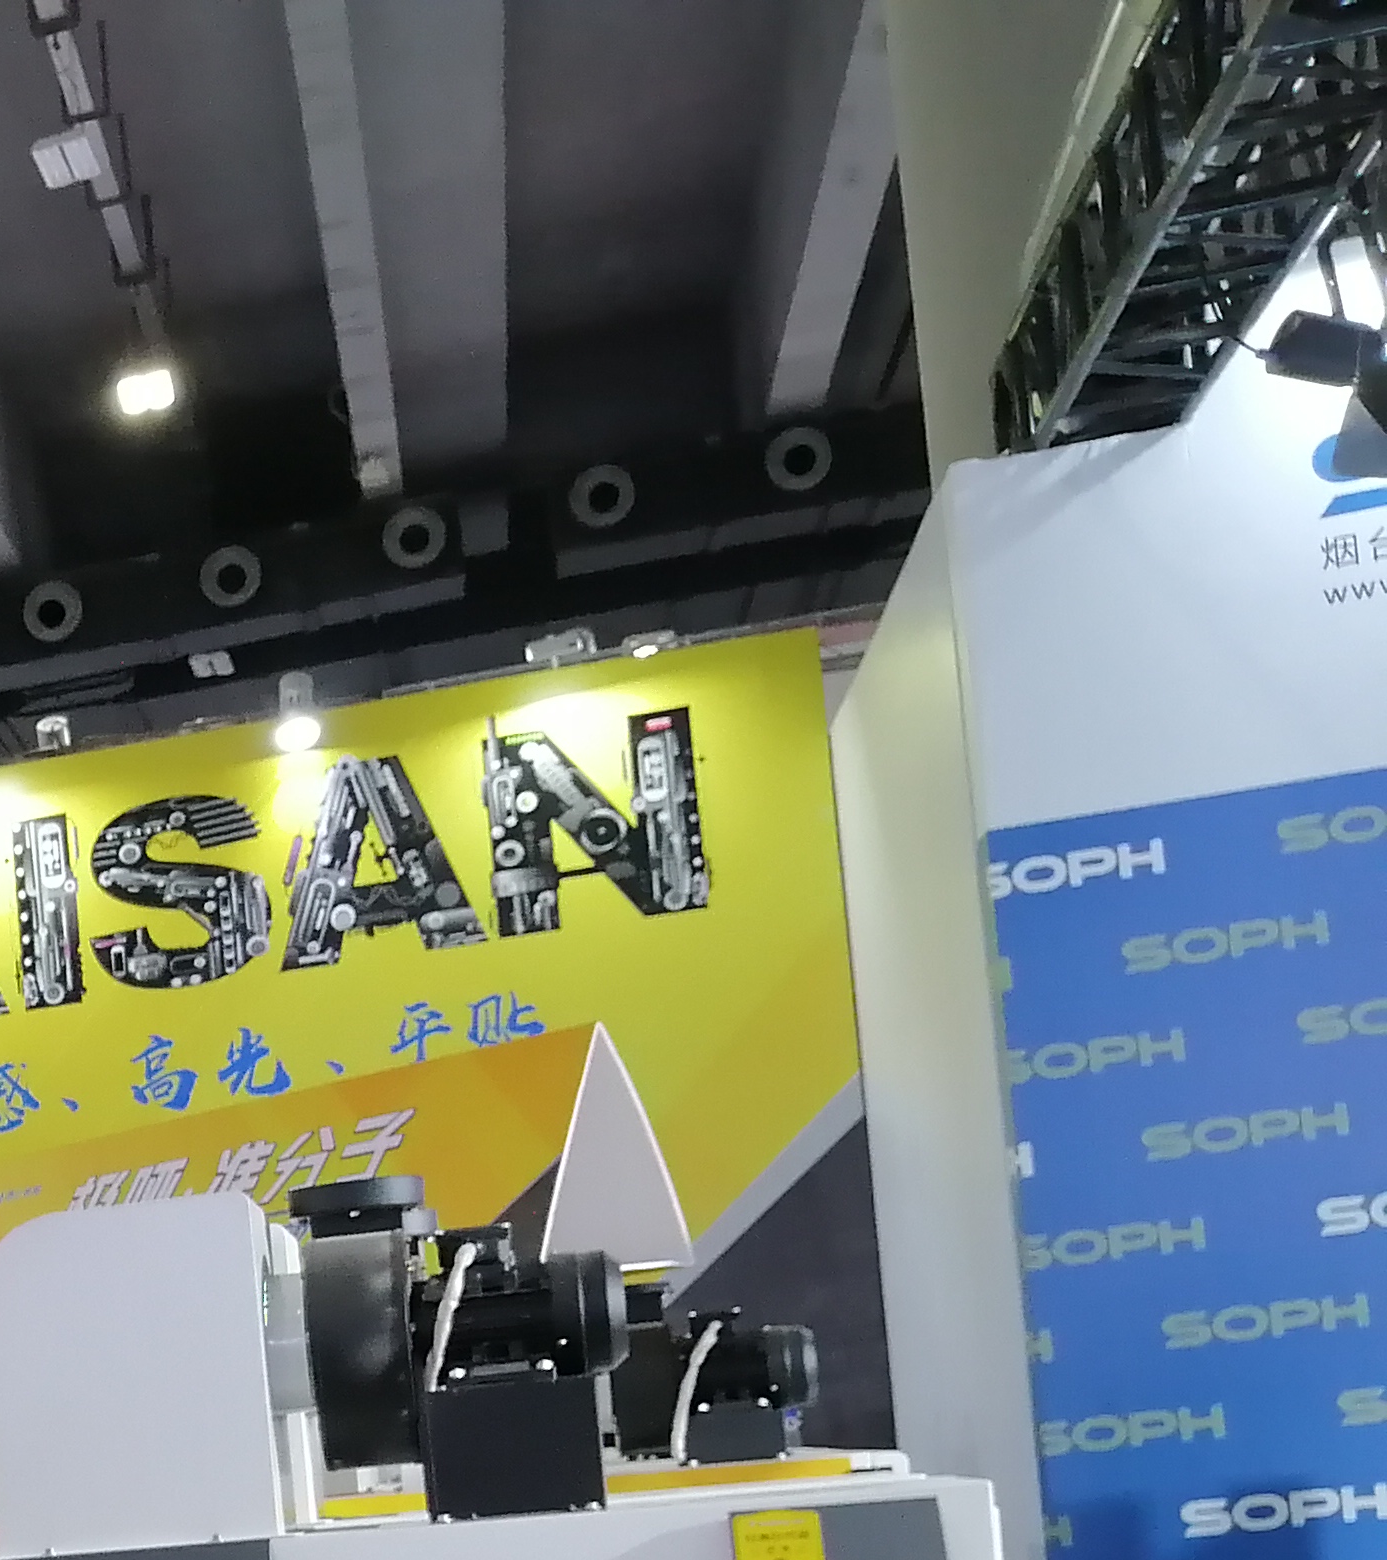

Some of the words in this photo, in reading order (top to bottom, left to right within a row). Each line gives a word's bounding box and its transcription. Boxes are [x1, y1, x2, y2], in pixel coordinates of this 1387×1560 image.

[1120, 910, 1330, 976] SOPH
[1141, 1102, 1351, 1163] SOPH
[1160, 1292, 1371, 1351] SOPH
[1178, 1484, 1387, 1540] SOPH
